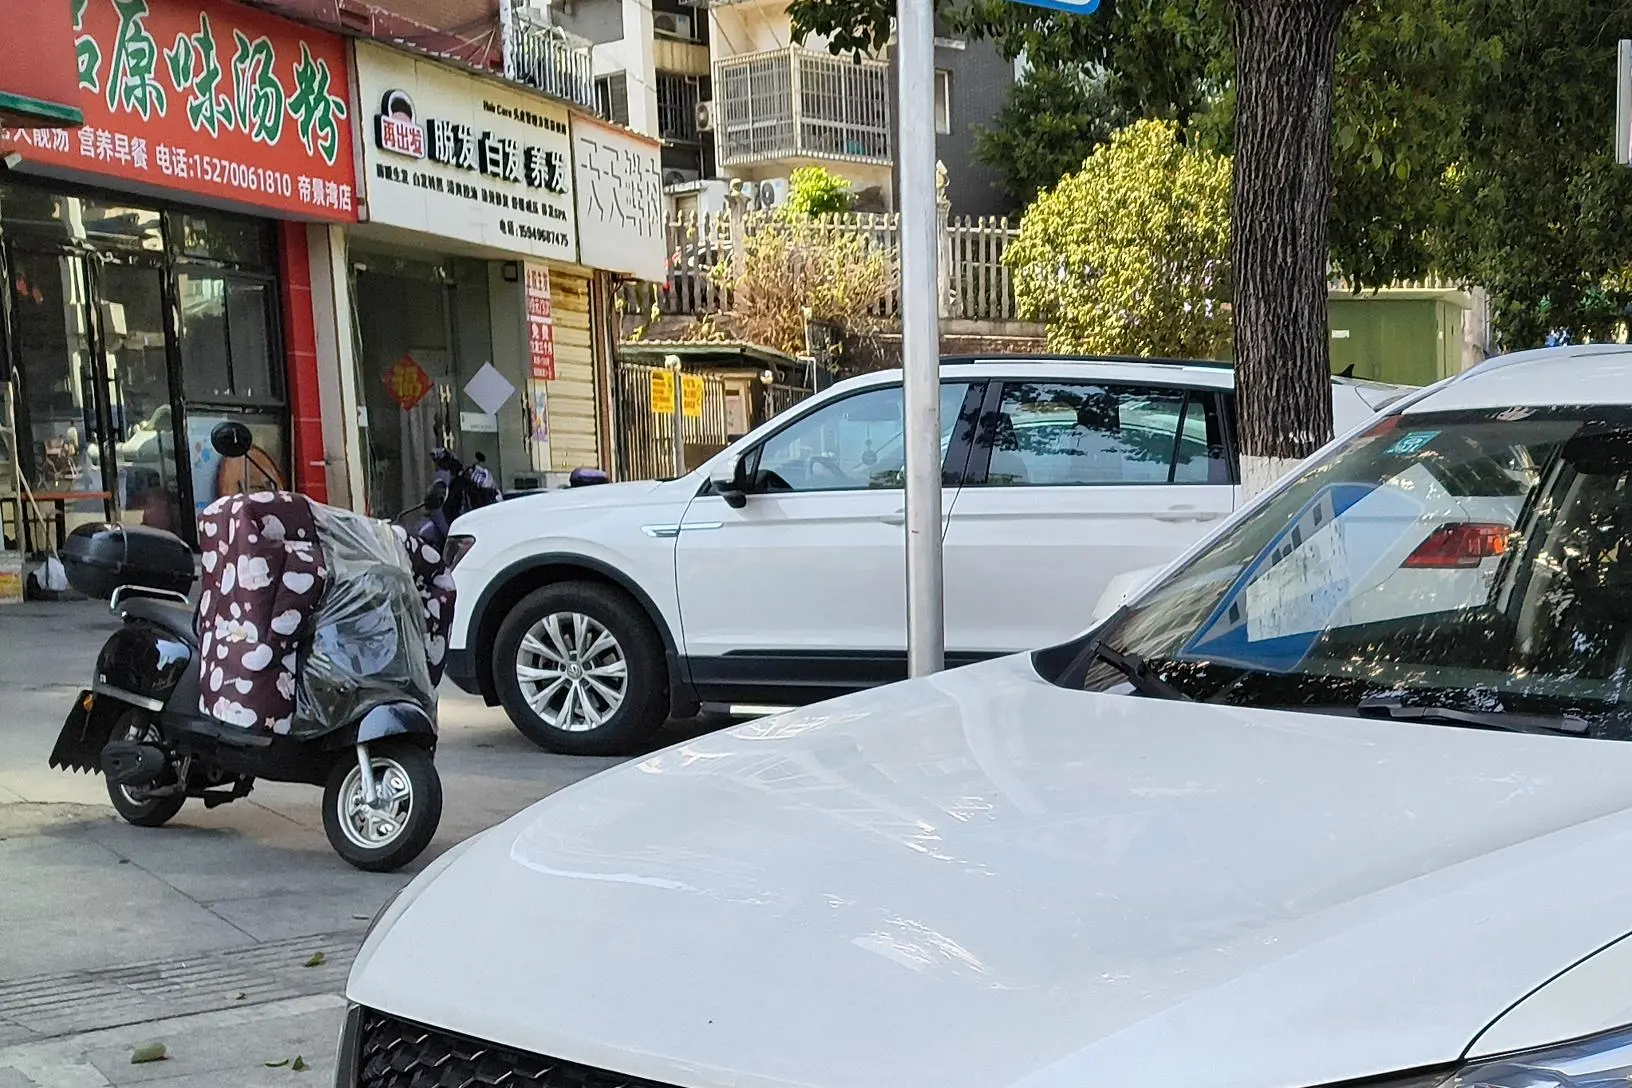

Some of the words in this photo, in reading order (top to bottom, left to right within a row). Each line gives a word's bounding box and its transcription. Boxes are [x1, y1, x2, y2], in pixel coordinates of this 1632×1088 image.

[78, 125, 148, 170] 营养早餐
[155, 143, 292, 197] 电话:15270061810
[297, 175, 352, 212] 帝景湾店
[383, 120, 423, 156] 再出发
[433, 120, 479, 170] 脱发
[484, 130, 523, 182] 白发
[530, 147, 568, 193] 养发
